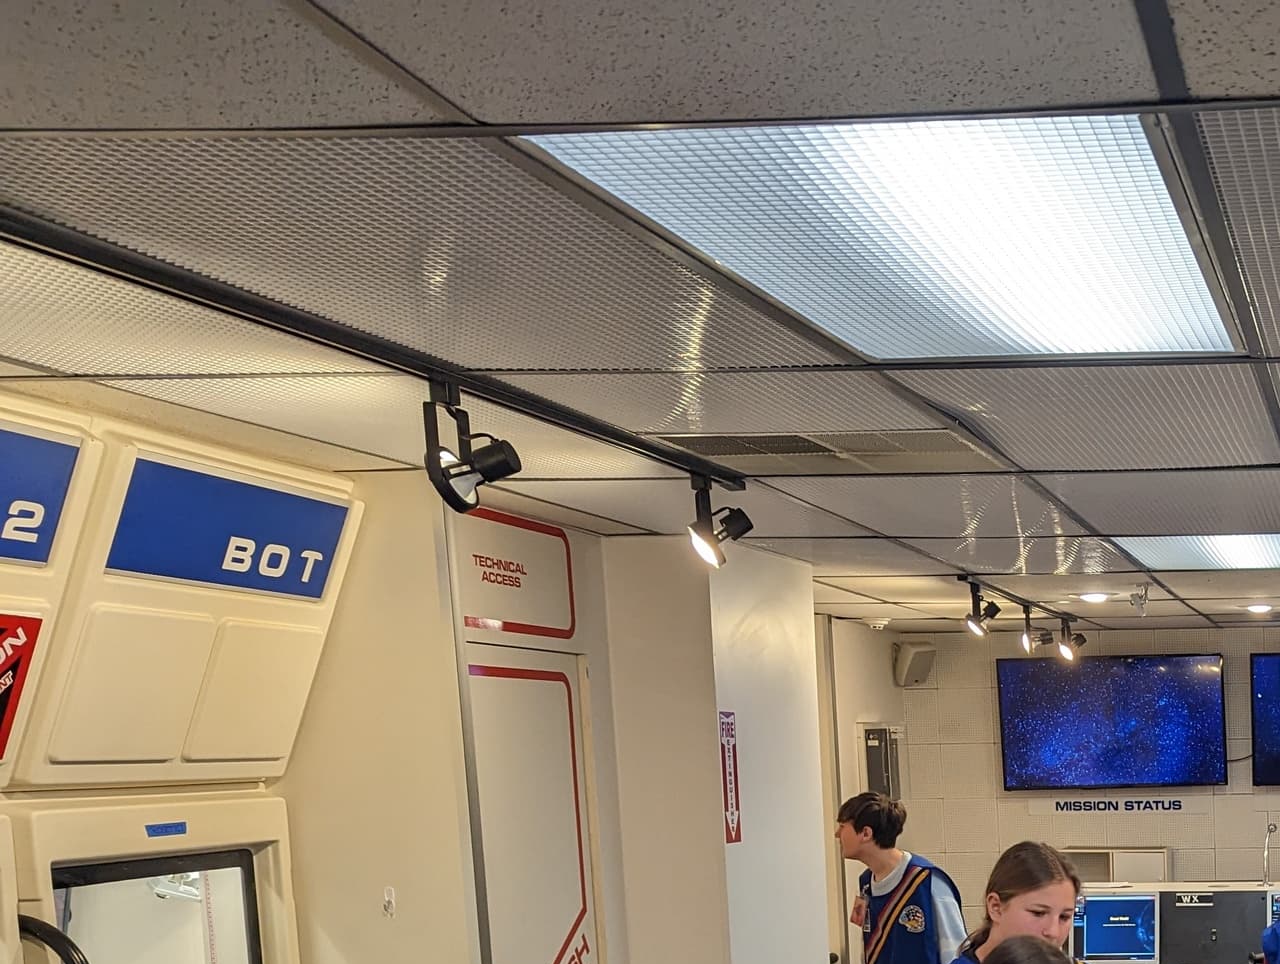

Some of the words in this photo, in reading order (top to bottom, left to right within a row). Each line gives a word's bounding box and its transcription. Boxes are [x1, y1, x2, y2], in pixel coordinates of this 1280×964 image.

[1, 500, 45, 543] 2
[221, 536, 324, 583] BOT
[472, 554, 527, 575] TECHNICAL
[482, 570, 521, 588] ACCESS
[721, 721, 735, 738] FIRE
[1055, 801, 1119, 812] MISSION
[1124, 800, 1182, 811] STATUS
